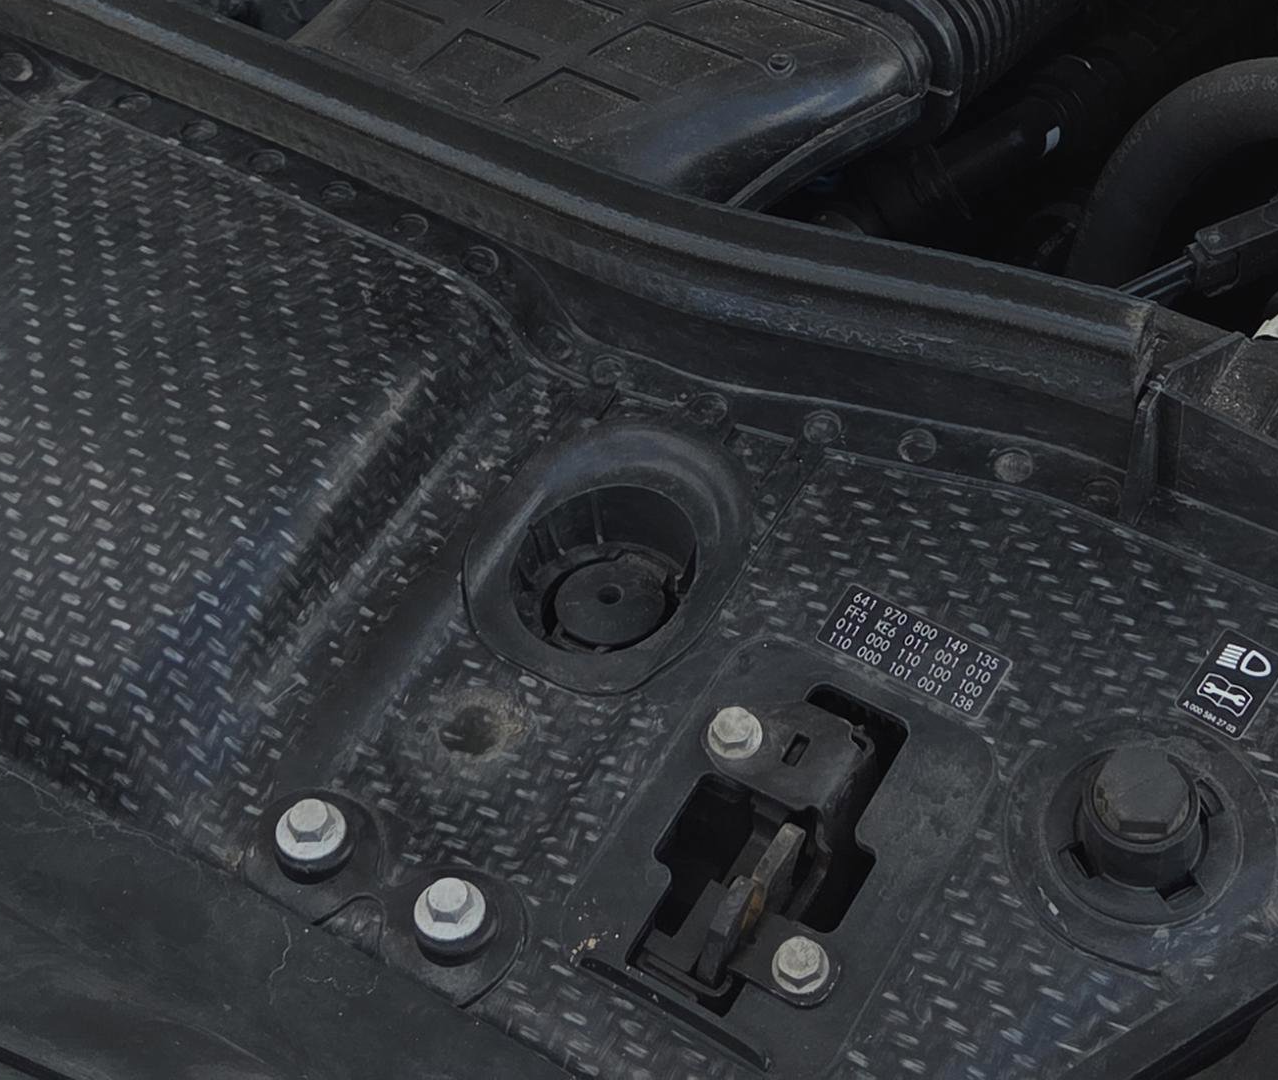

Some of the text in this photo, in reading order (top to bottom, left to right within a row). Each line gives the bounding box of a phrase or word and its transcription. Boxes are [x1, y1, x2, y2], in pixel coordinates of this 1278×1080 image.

[836, 618, 982, 697] 011 000 110 100 100
[844, 604, 991, 684] FF5 KE6 011 001 010
[853, 593, 999, 670] 641 970 800 149 135
[829, 632, 974, 711] 110 000 101 001 138
[1183, 700, 1191, 709] A
[1189, 704, 1203, 715] 000
[1217, 718, 1227, 727] 27
